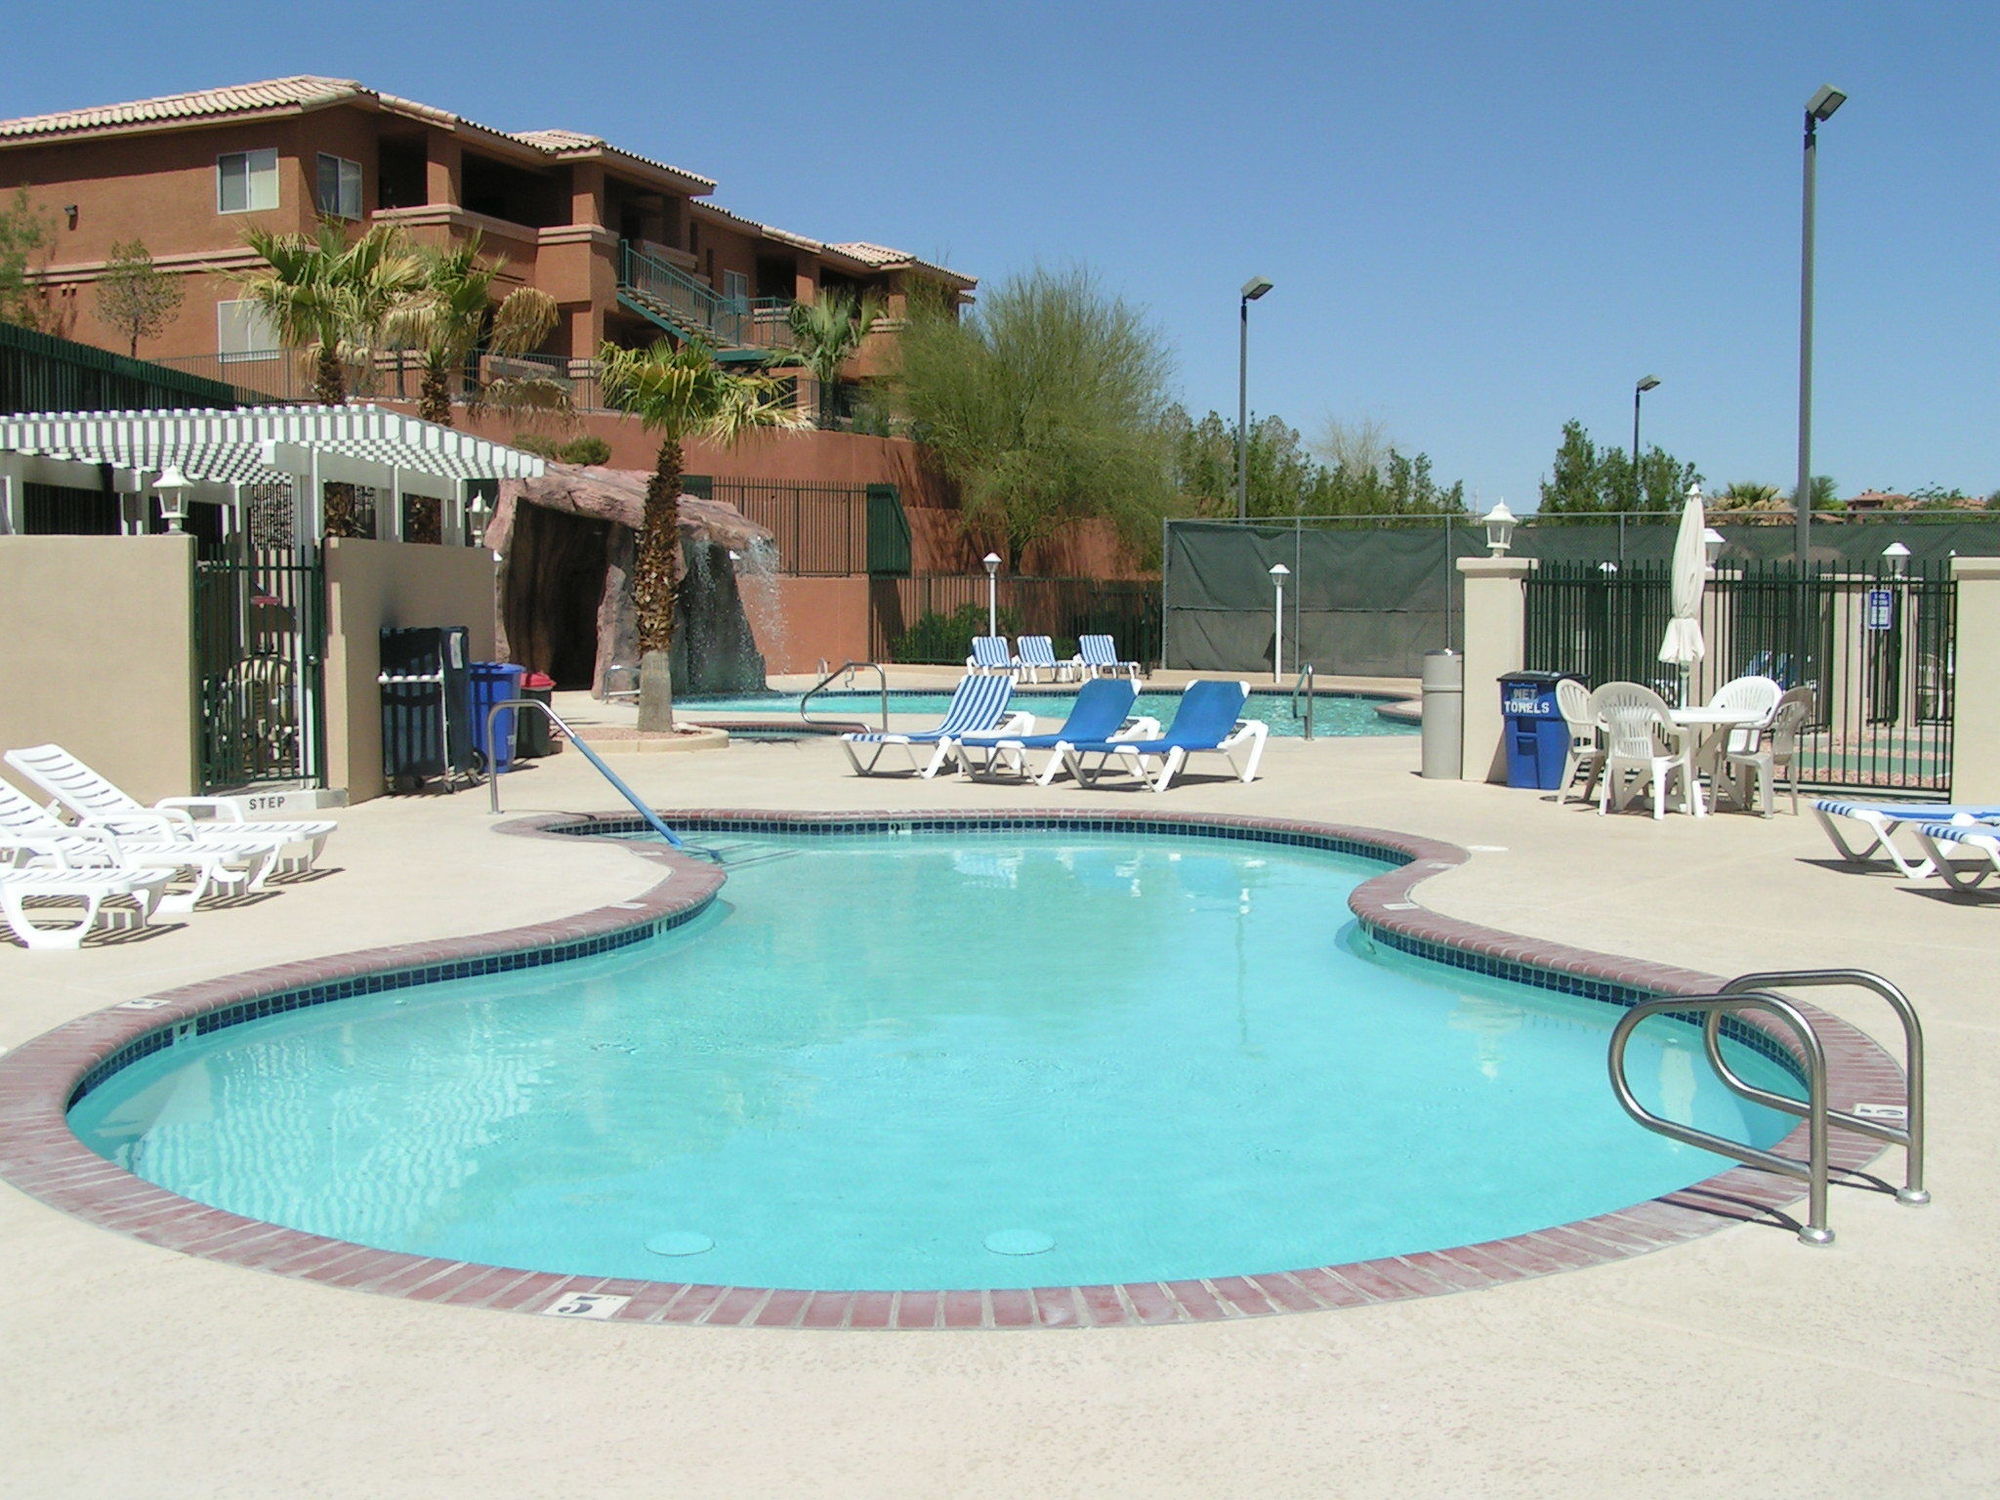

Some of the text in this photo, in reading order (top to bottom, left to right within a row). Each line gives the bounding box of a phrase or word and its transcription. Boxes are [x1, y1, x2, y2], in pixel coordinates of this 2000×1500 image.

[1504, 701, 1550, 714] TOWELS
[249, 796, 285, 810] STEP
[558, 1295, 602, 1314] 5
